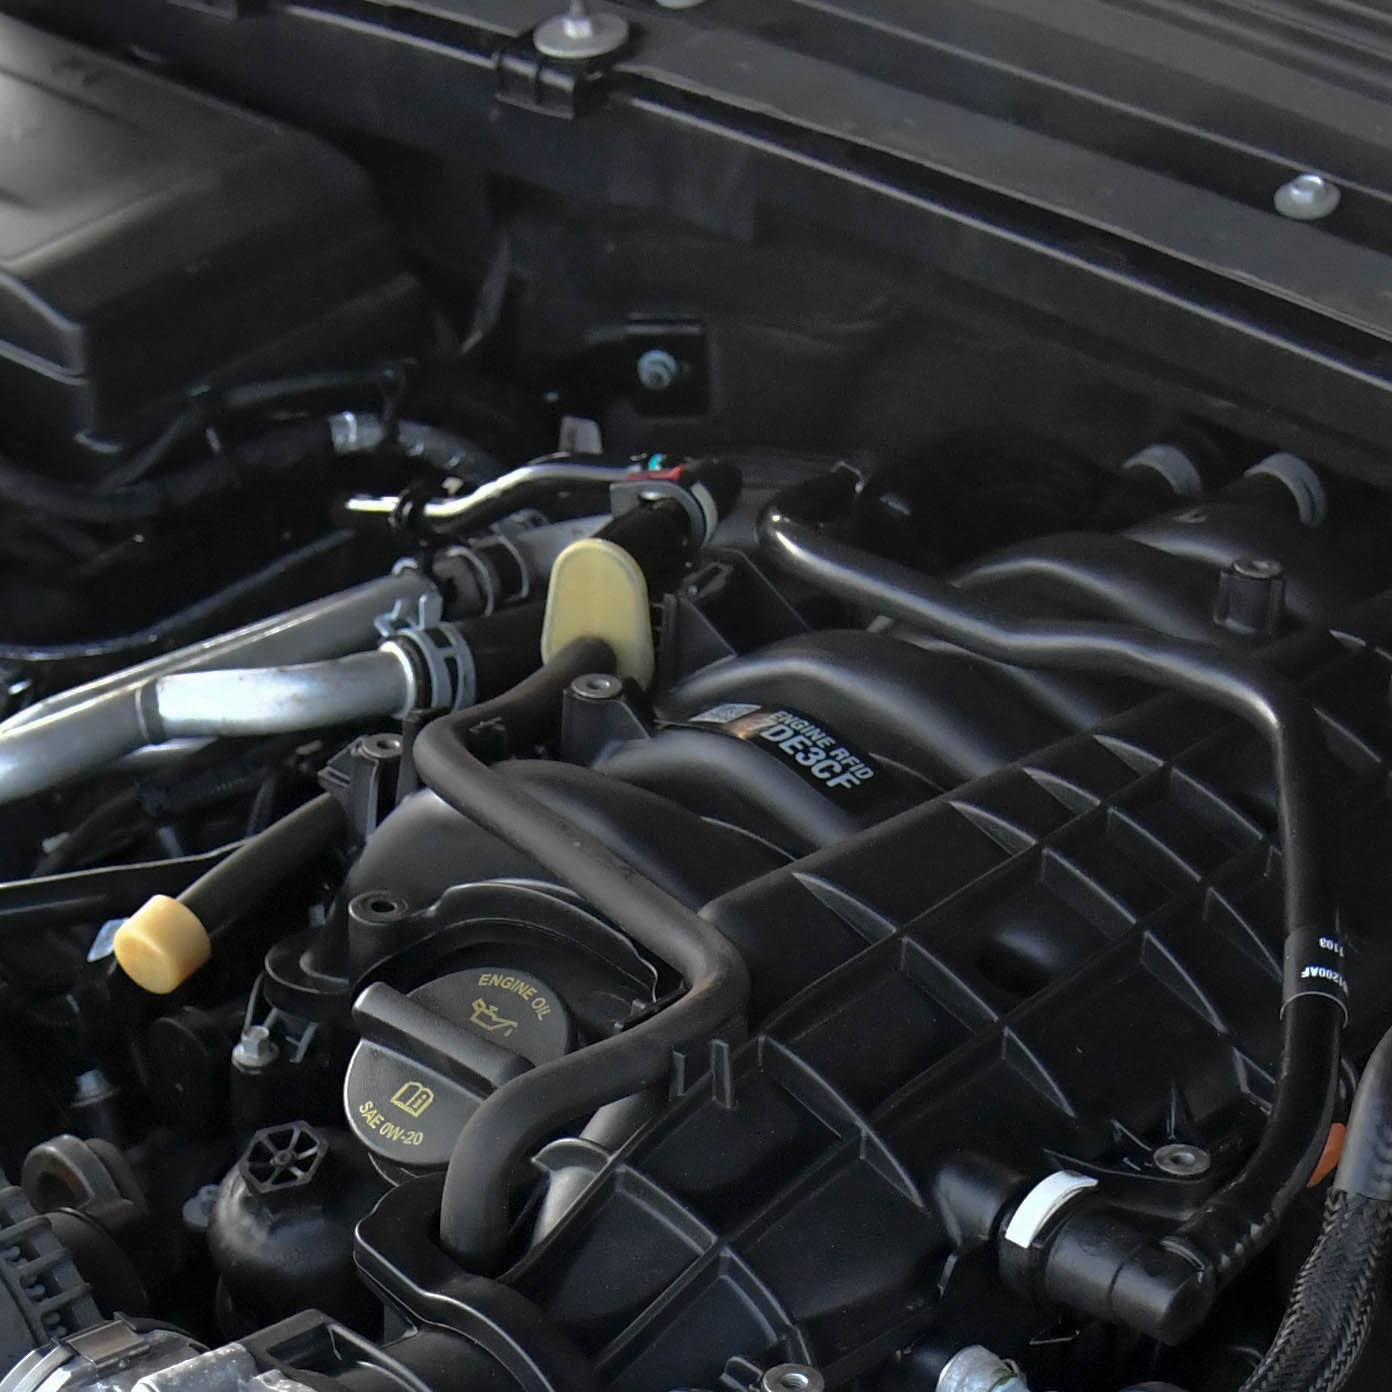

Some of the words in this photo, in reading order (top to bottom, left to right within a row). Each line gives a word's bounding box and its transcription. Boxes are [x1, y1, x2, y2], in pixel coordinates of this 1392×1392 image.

[760, 723, 861, 790] DE3CF
[773, 710, 836, 749] ENGINE
[829, 747, 875, 781] RFID
[478, 972, 537, 1001] ENGINE
[531, 997, 553, 1021] OIL
[359, 1100, 384, 1130] SAE
[379, 1119, 424, 1146] 0W-20
